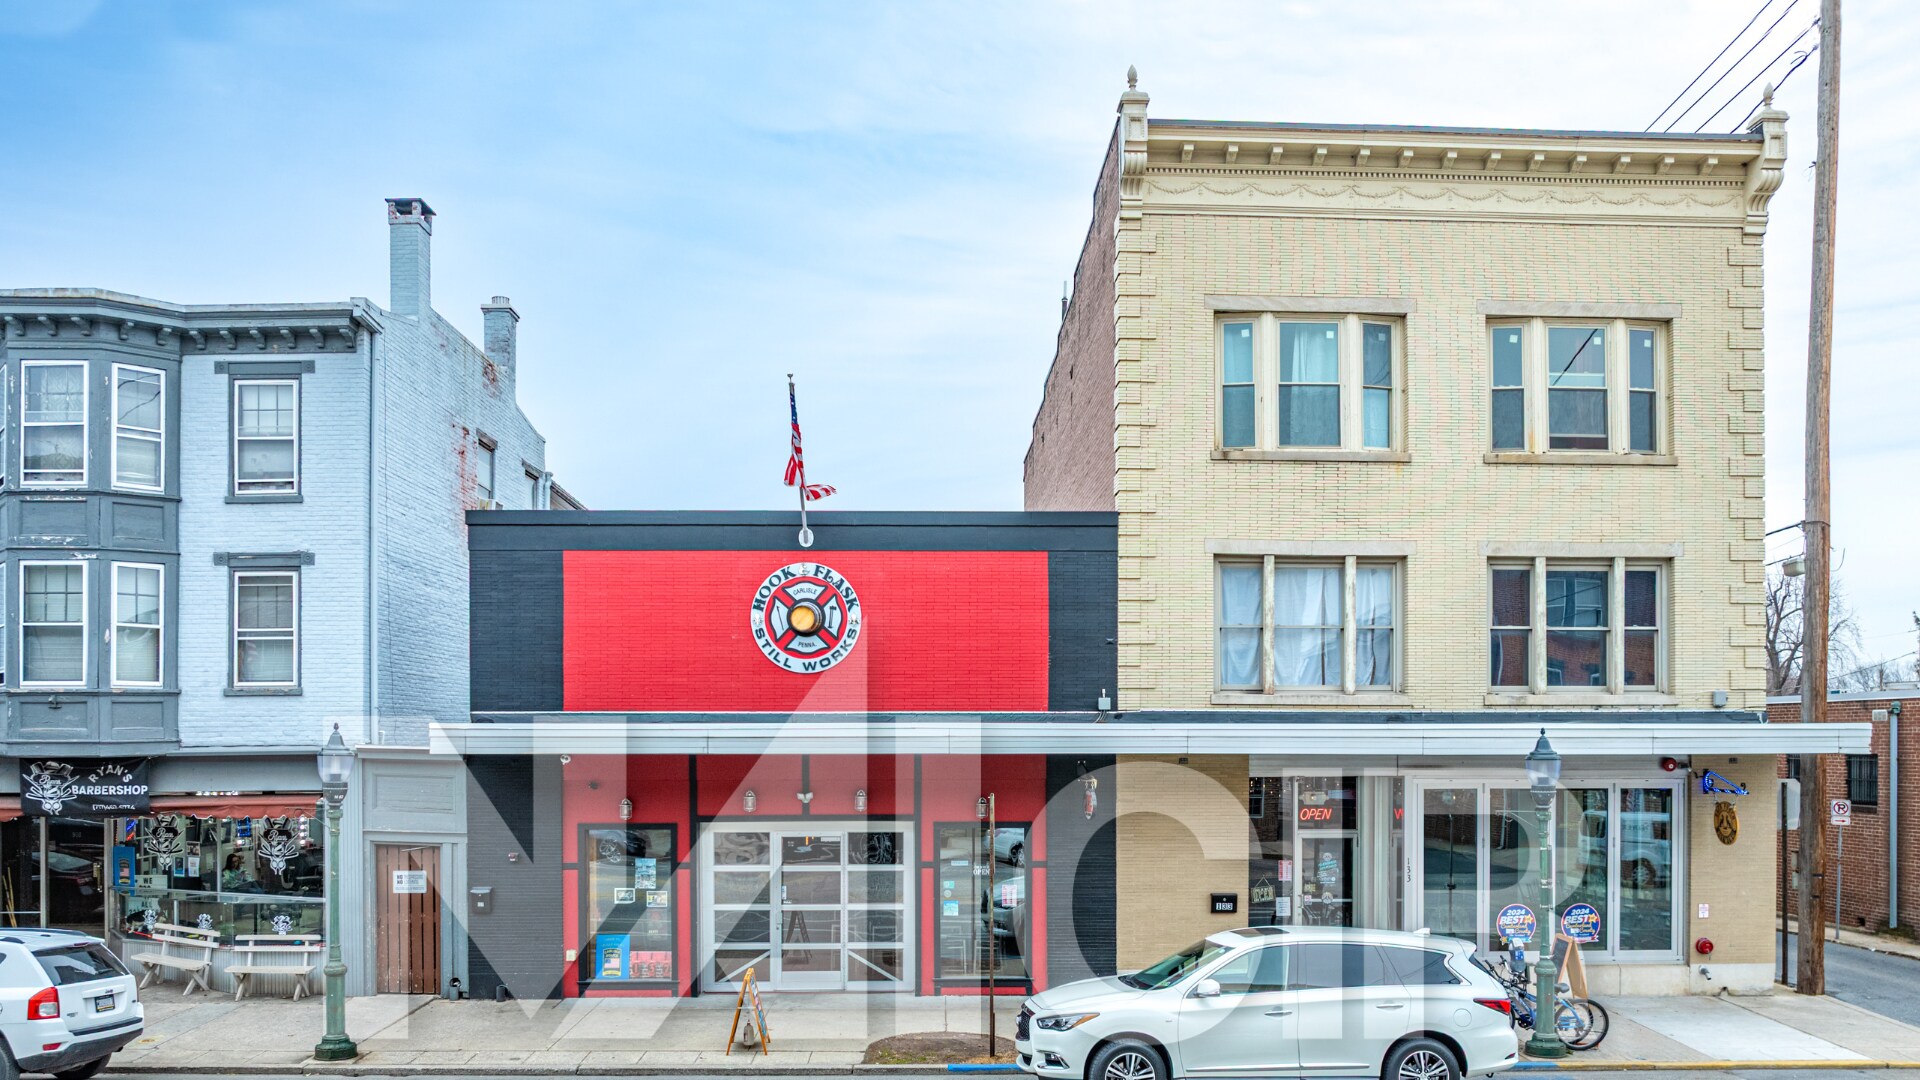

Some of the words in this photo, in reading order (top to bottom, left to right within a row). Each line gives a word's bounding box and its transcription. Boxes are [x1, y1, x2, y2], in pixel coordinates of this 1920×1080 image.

[752, 565, 796, 612] HOOK
[813, 565, 860, 612] FLASK
[793, 585, 818, 595] CARLISLE
[755, 628, 792, 669] STILL
[802, 628, 857, 671] WORKS
[88, 764, 133, 784] RYAN'S
[71, 784, 148, 796] BARBERSHOP
[1300, 808, 1332, 821] OPEN
[973, 868, 991, 876] OPEN
[1216, 902, 1233, 911] 133
[1500, 915, 1524, 924] BEST
[1564, 915, 1588, 924] BEST
